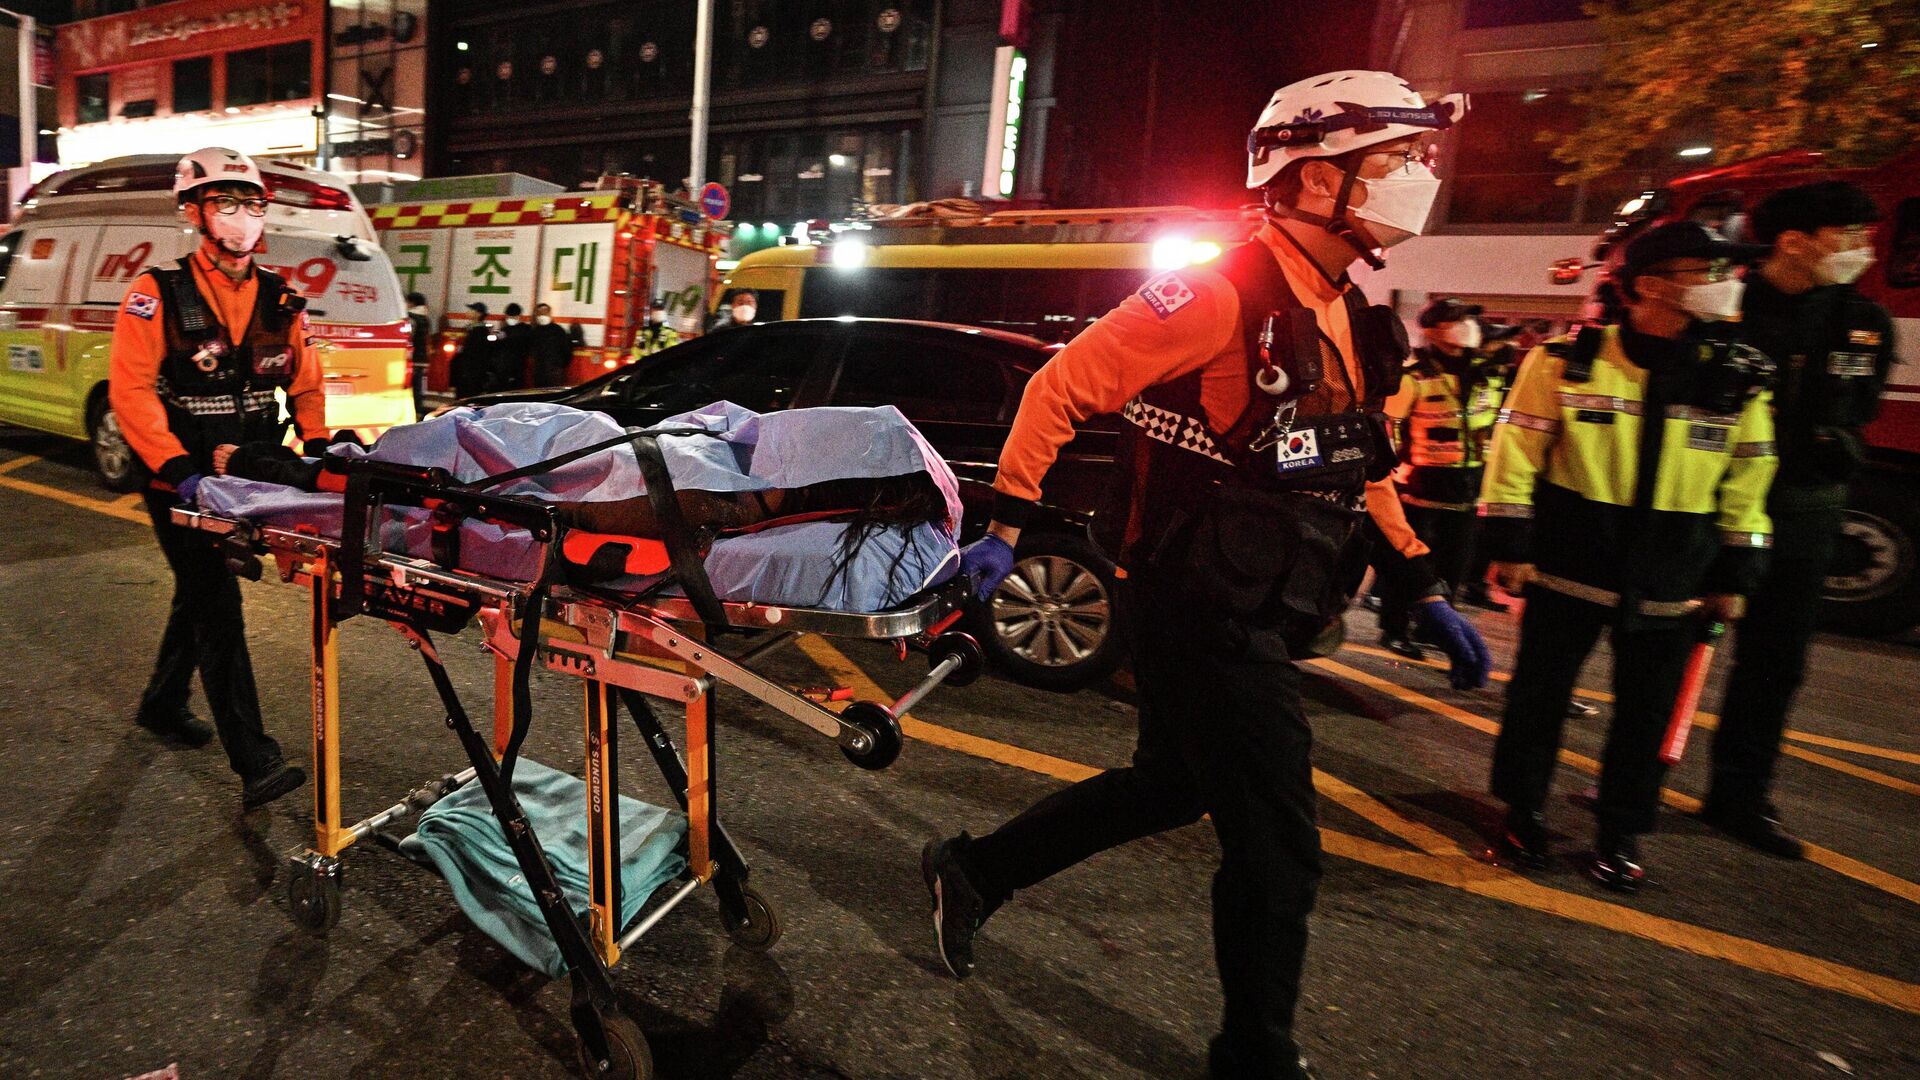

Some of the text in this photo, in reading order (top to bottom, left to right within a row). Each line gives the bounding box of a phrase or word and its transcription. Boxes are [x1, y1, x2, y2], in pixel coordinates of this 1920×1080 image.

[95, 241, 153, 281] 119
[395, 242, 599, 305] 구조대
[1143, 290, 1166, 314] KOREA
[259, 353, 289, 369] 119
[1282, 458, 1316, 470] KOREA
[591, 750, 601, 813] SUNGWOO
